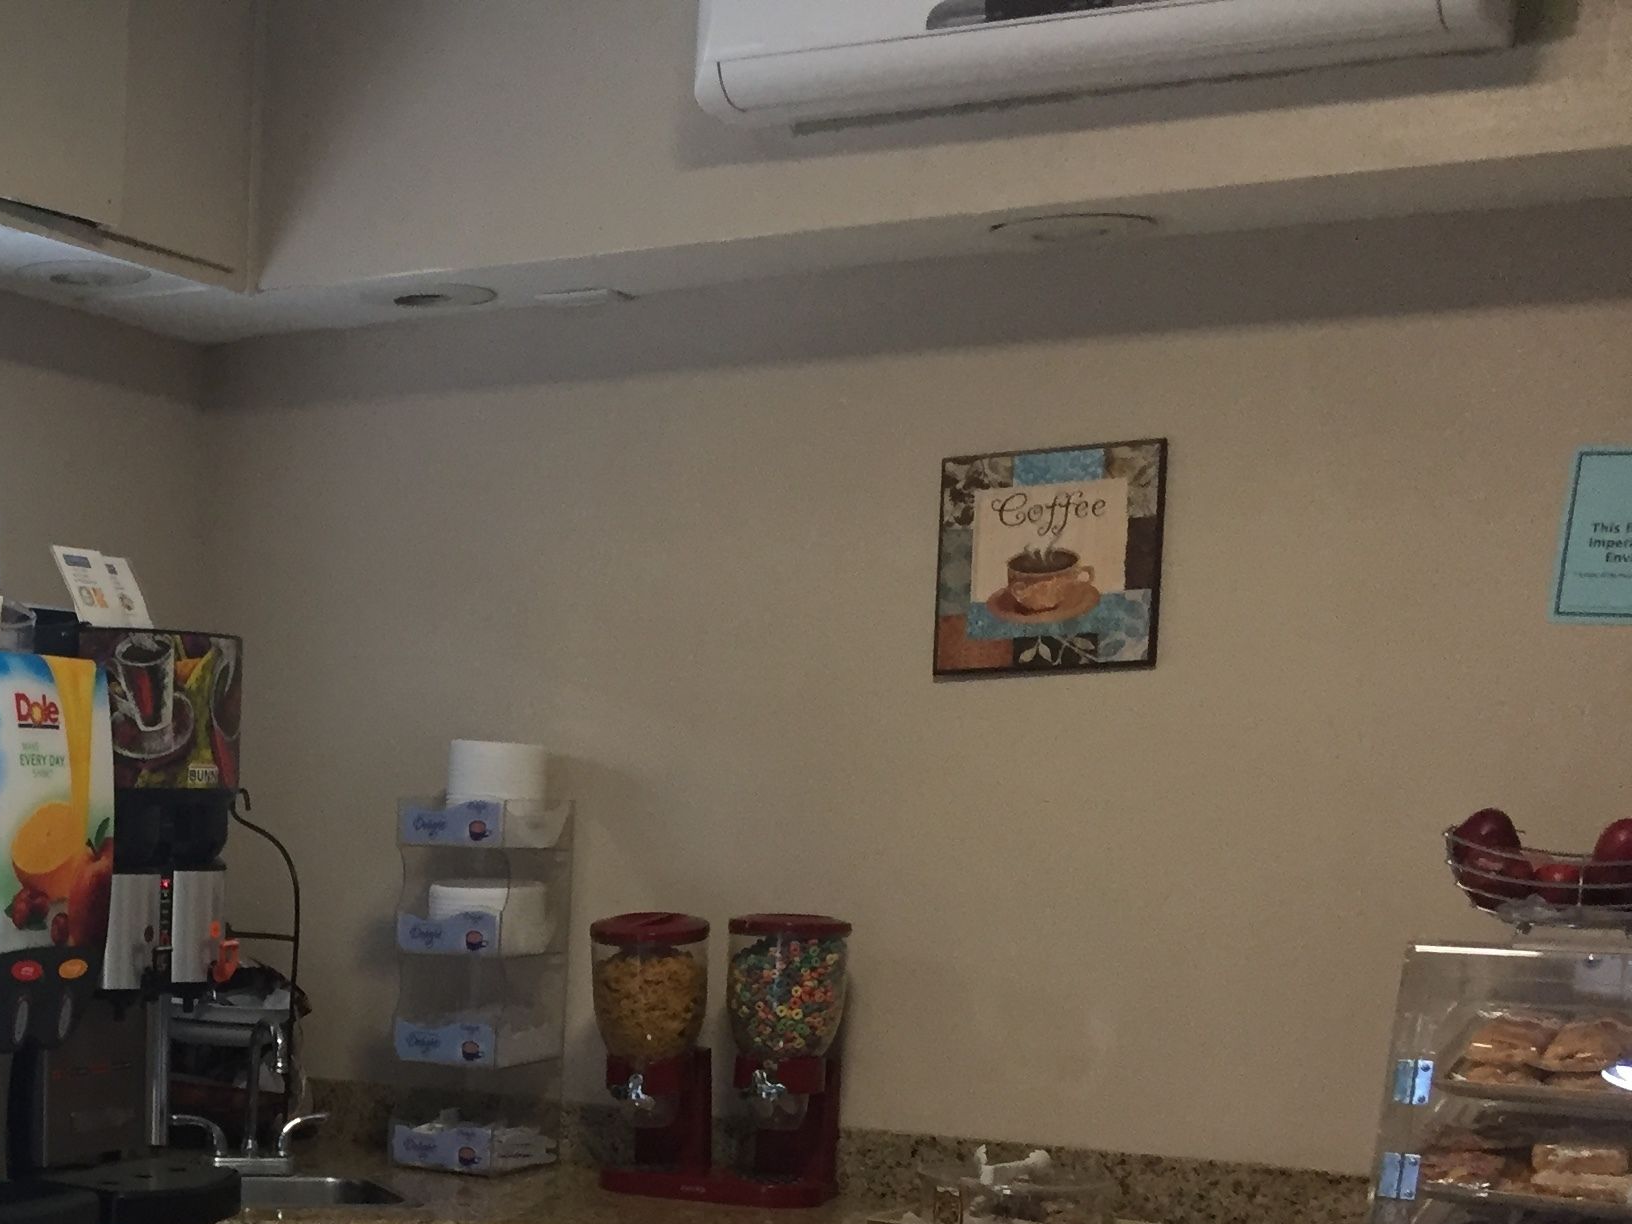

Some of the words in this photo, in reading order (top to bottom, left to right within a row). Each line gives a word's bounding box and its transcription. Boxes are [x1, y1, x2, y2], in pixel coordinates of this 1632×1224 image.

[992, 491, 1107, 537] Coffee
[1590, 521, 1621, 534] This
[14, 693, 60, 725] Dole
[19, 753, 48, 767] EVERY
[49, 755, 65, 767] DAY
